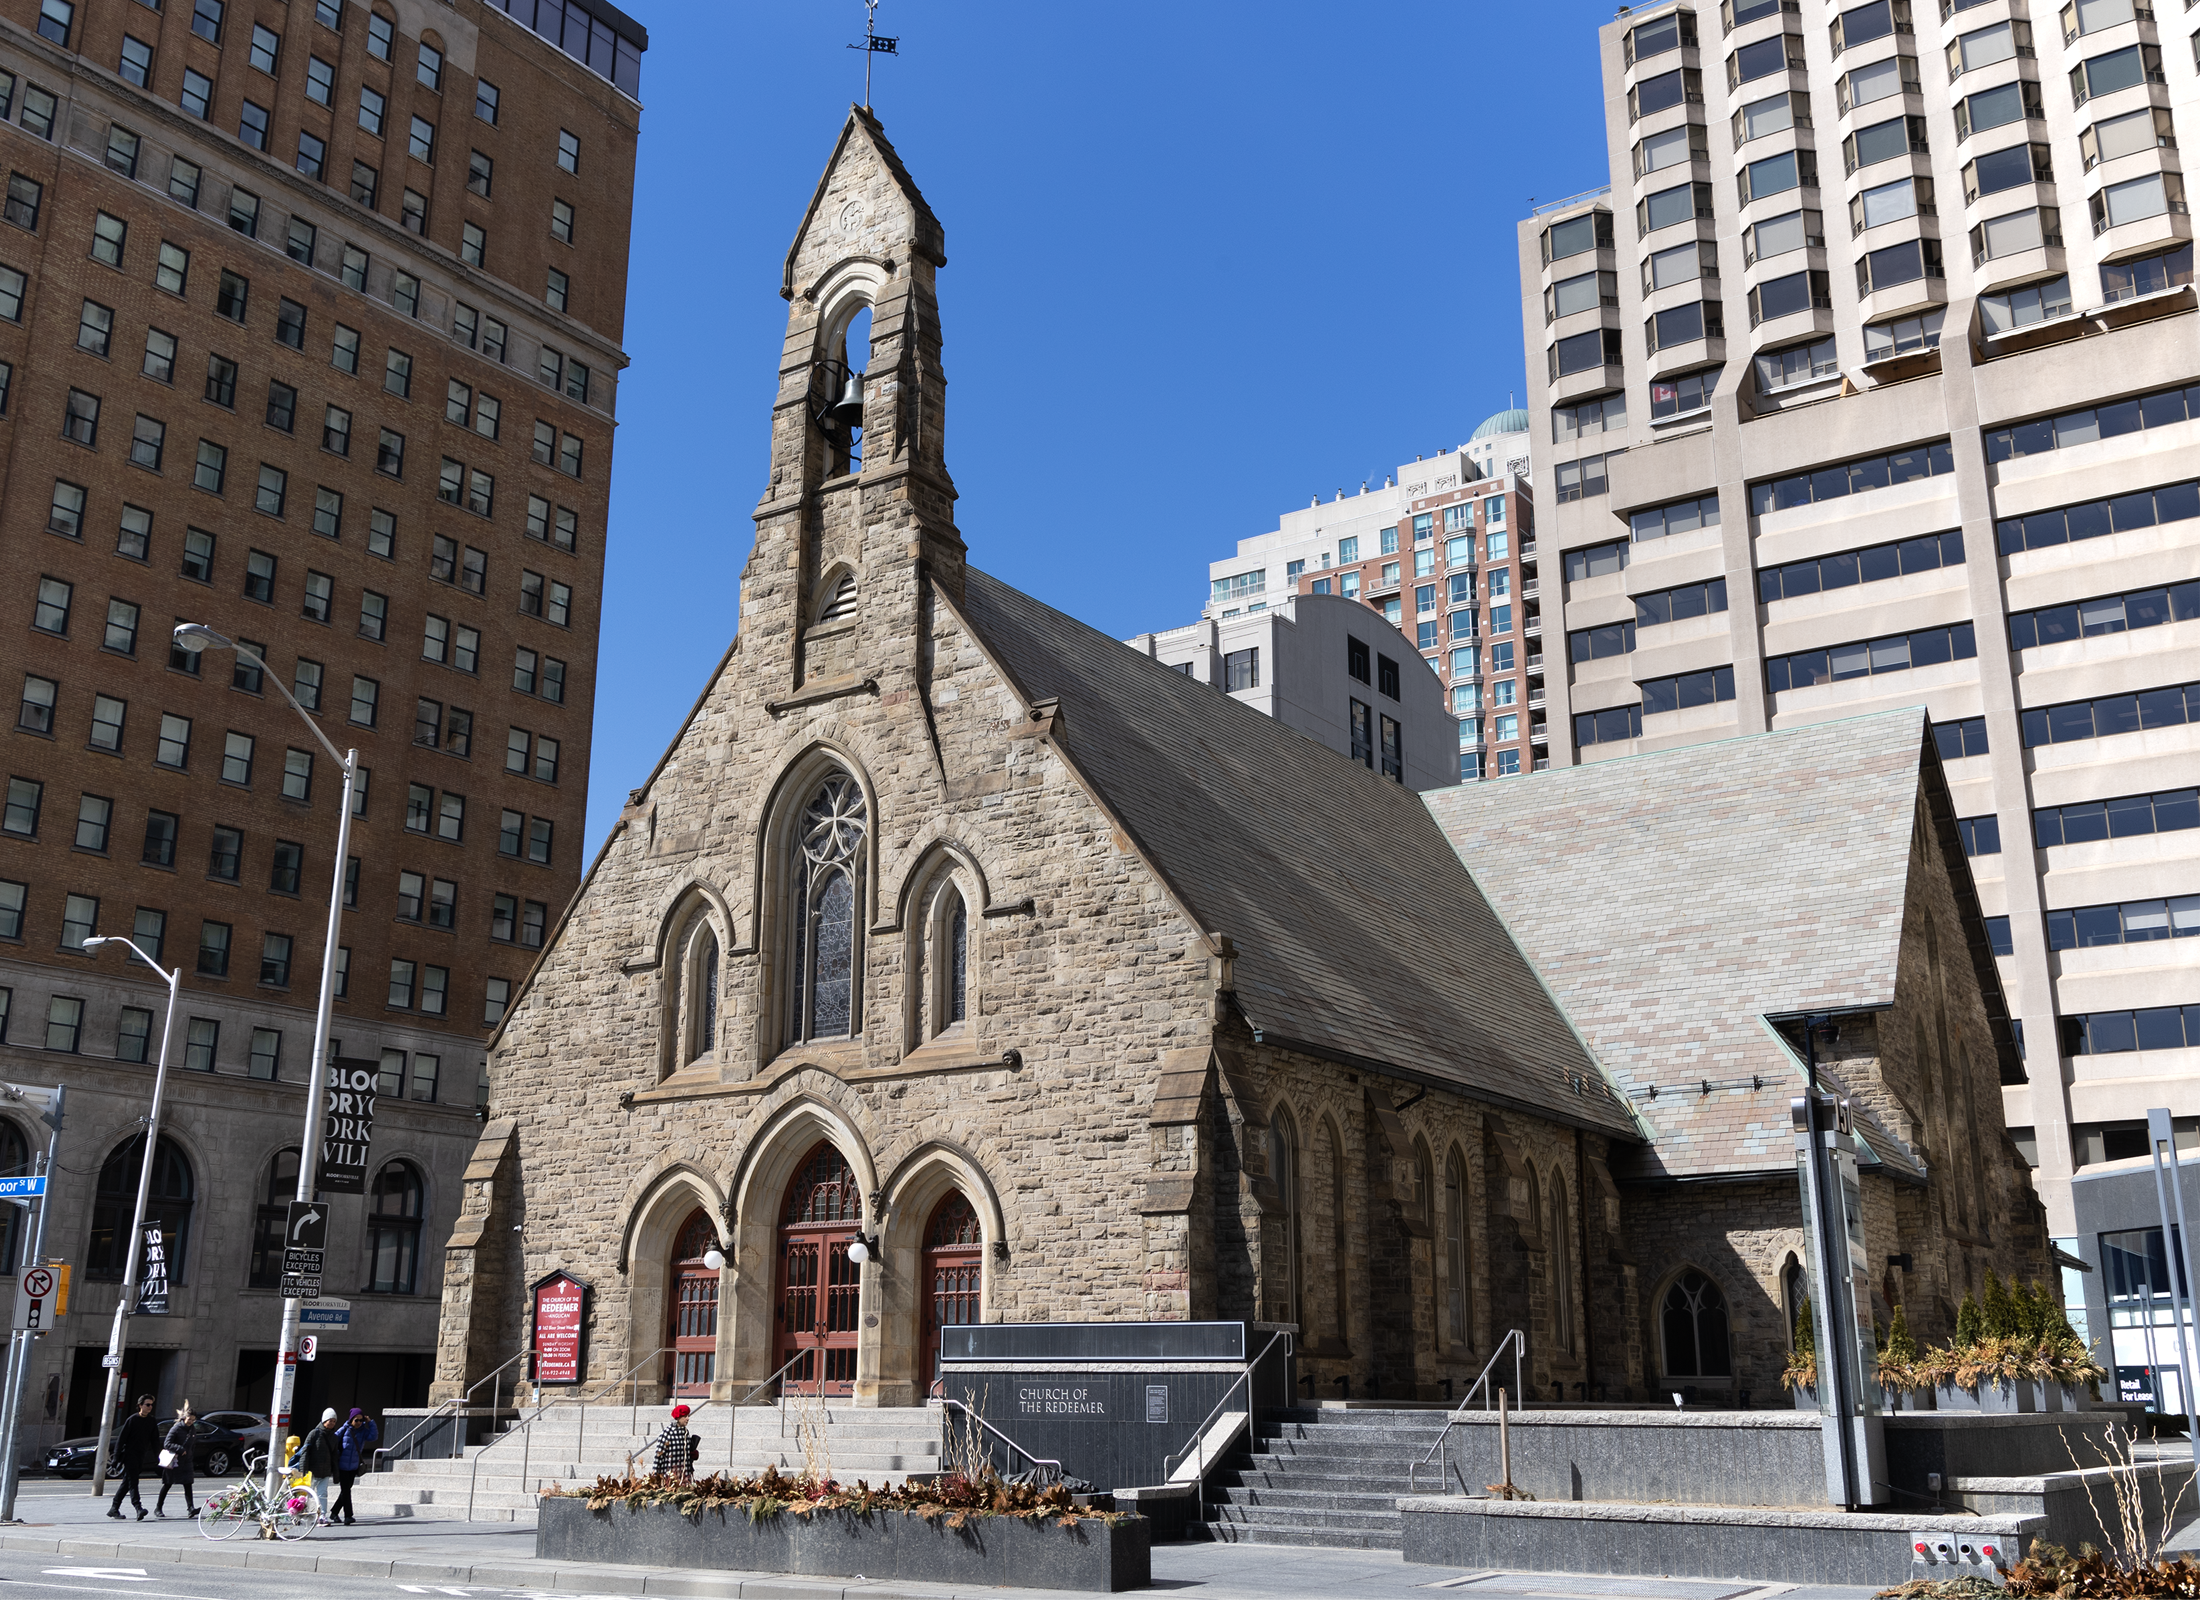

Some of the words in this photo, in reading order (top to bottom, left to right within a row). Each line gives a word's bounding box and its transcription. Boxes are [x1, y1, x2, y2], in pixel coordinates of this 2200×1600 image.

[28, 1179, 37, 1191] W
[289, 1252, 320, 1262] BICYCLES
[286, 1261, 320, 1271] EXCEPTED
[283, 1278, 294, 1286] TTC
[296, 1278, 320, 1287] VEHICLES
[283, 1287, 317, 1296] EXCEPTED
[302, 1300, 349, 1308] BLOORYORKVILLE
[541, 1303, 578, 1312] REDEEMER
[307, 1311, 334, 1322] Avenue
[335, 1313, 343, 1321] Rd
[2120, 1379, 2141, 1389] Retail
[1019, 1388, 1069, 1400] CHURCH
[1072, 1388, 1088, 1400] OF
[2121, 1391, 2133, 1401] For
[2134, 1391, 2153, 1401] Lease
[1019, 1401, 1041, 1412] THE
[1045, 1401, 1105, 1413] REDEEMER
